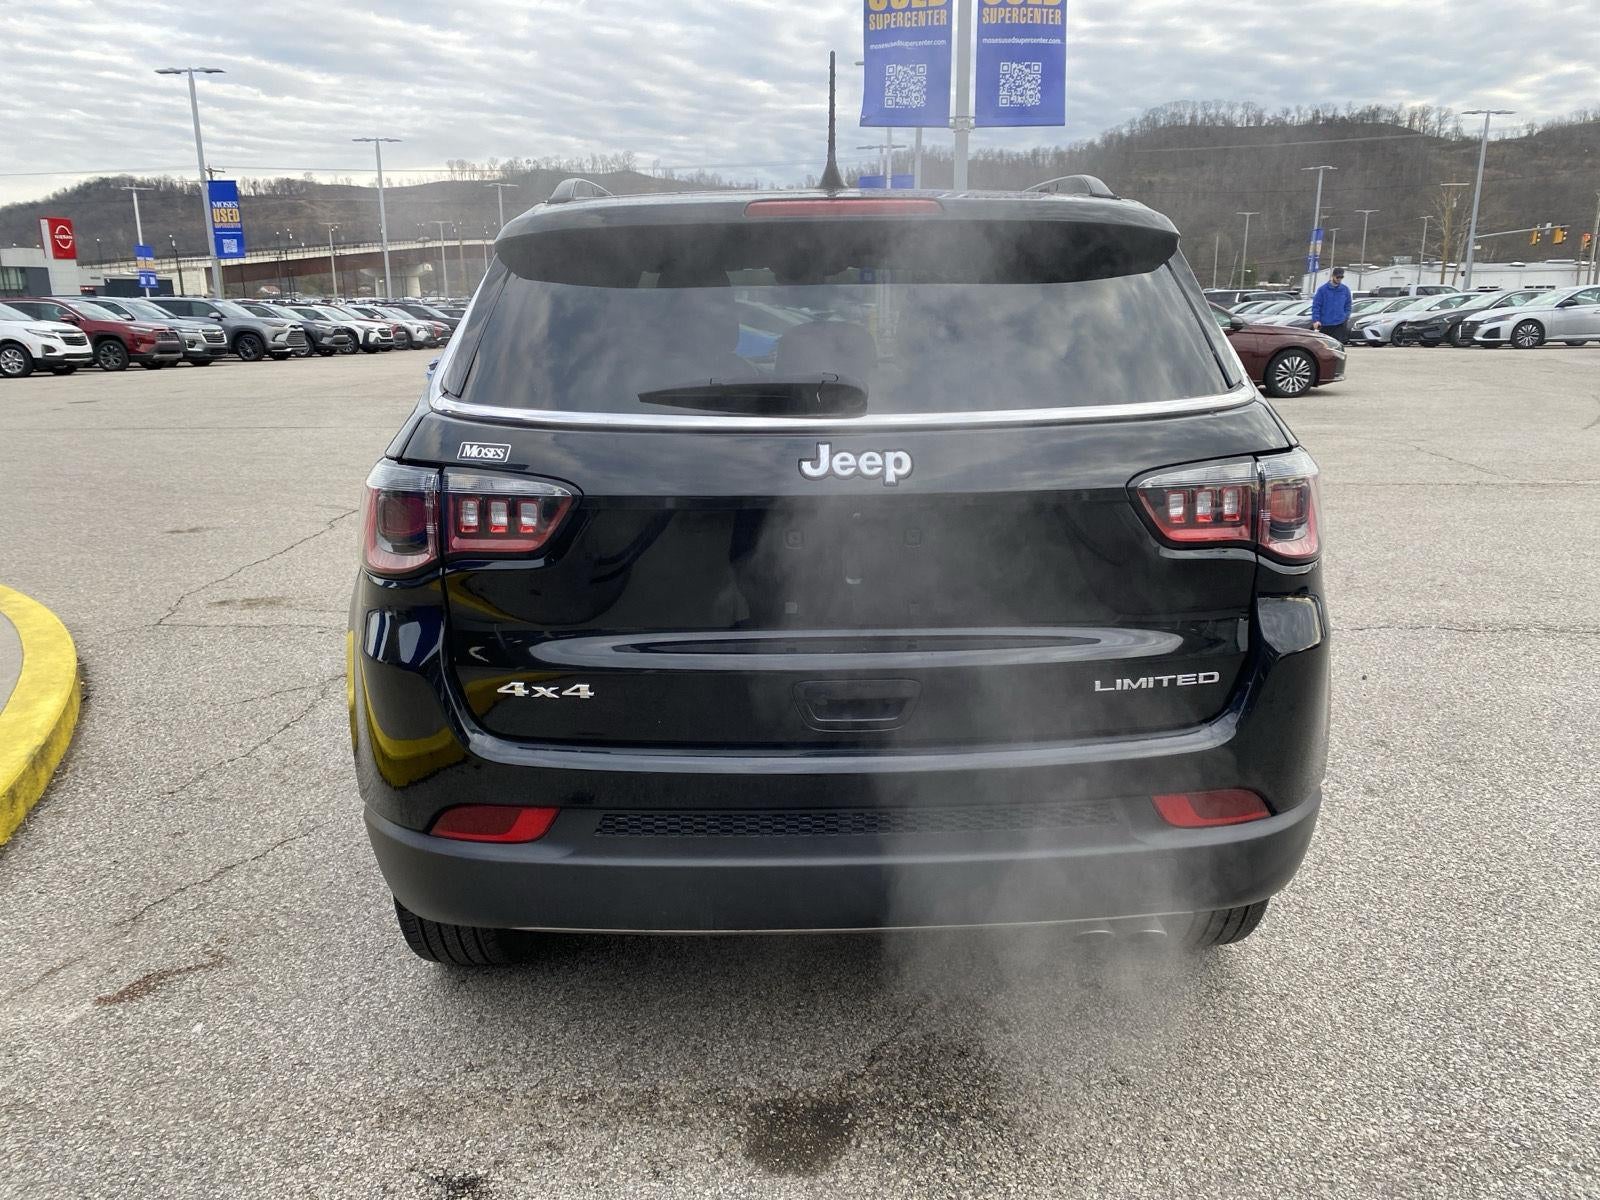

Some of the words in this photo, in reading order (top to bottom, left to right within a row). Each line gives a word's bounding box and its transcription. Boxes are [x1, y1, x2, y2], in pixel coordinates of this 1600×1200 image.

[869, 10, 947, 31] SUPERCENTER
[983, 7, 1061, 24] SUPERCENTER
[213, 208, 240, 222] USED
[800, 443, 912, 484] Jeep
[496, 682, 595, 699] 4x4
[1095, 671, 1219, 692] LIMITED
